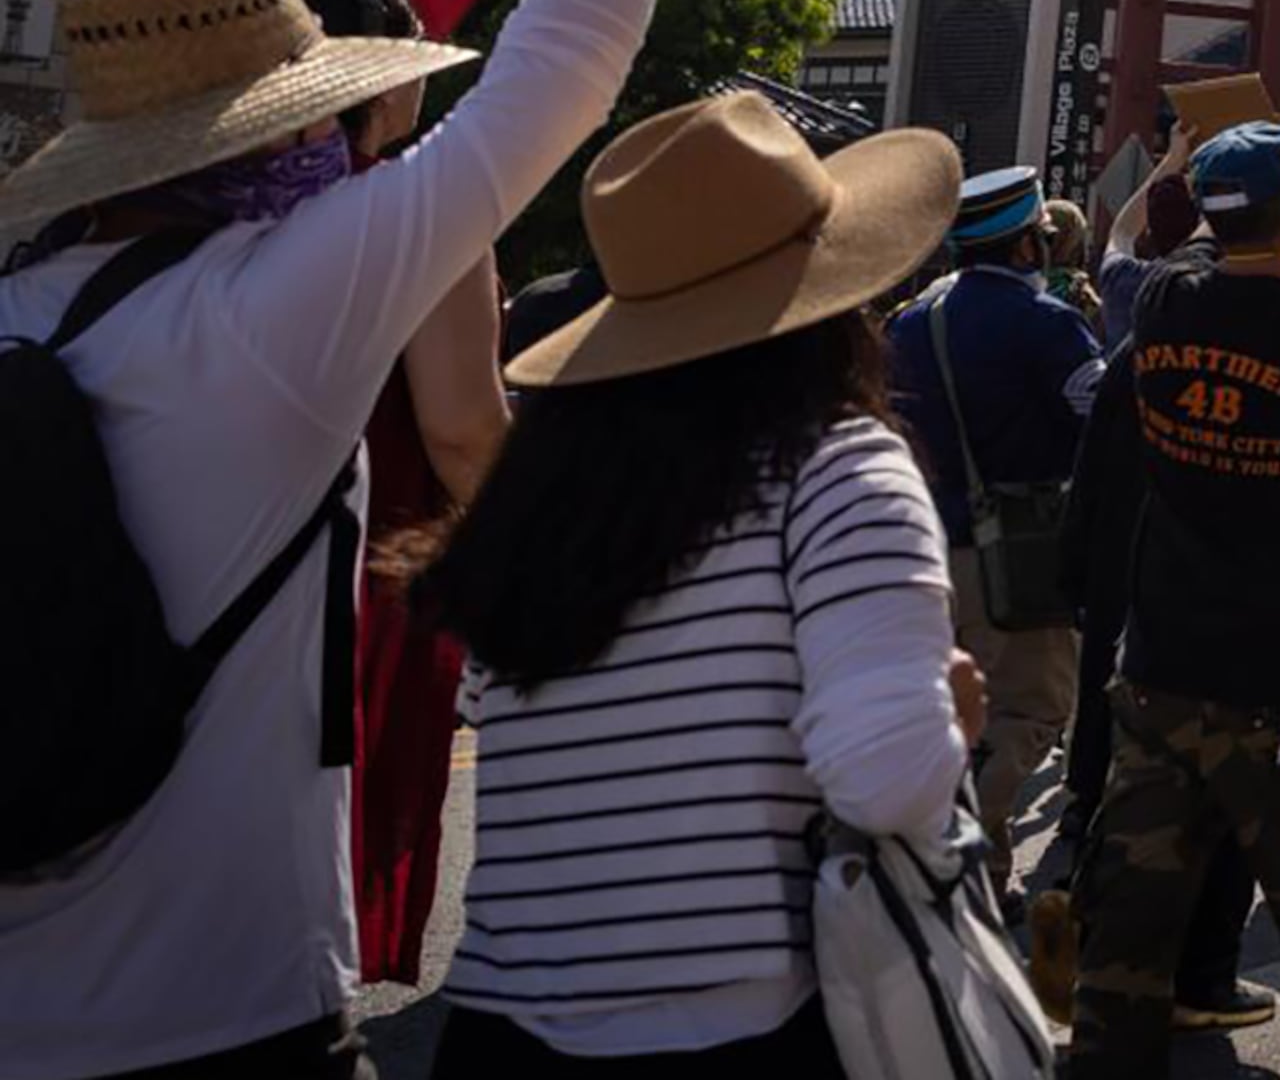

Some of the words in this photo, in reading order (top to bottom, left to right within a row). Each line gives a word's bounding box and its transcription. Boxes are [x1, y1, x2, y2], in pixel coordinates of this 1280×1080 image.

[1058, 11, 1080, 71] Plaza
[1050, 81, 1074, 157] Village
[1175, 379, 1243, 424] 4B
